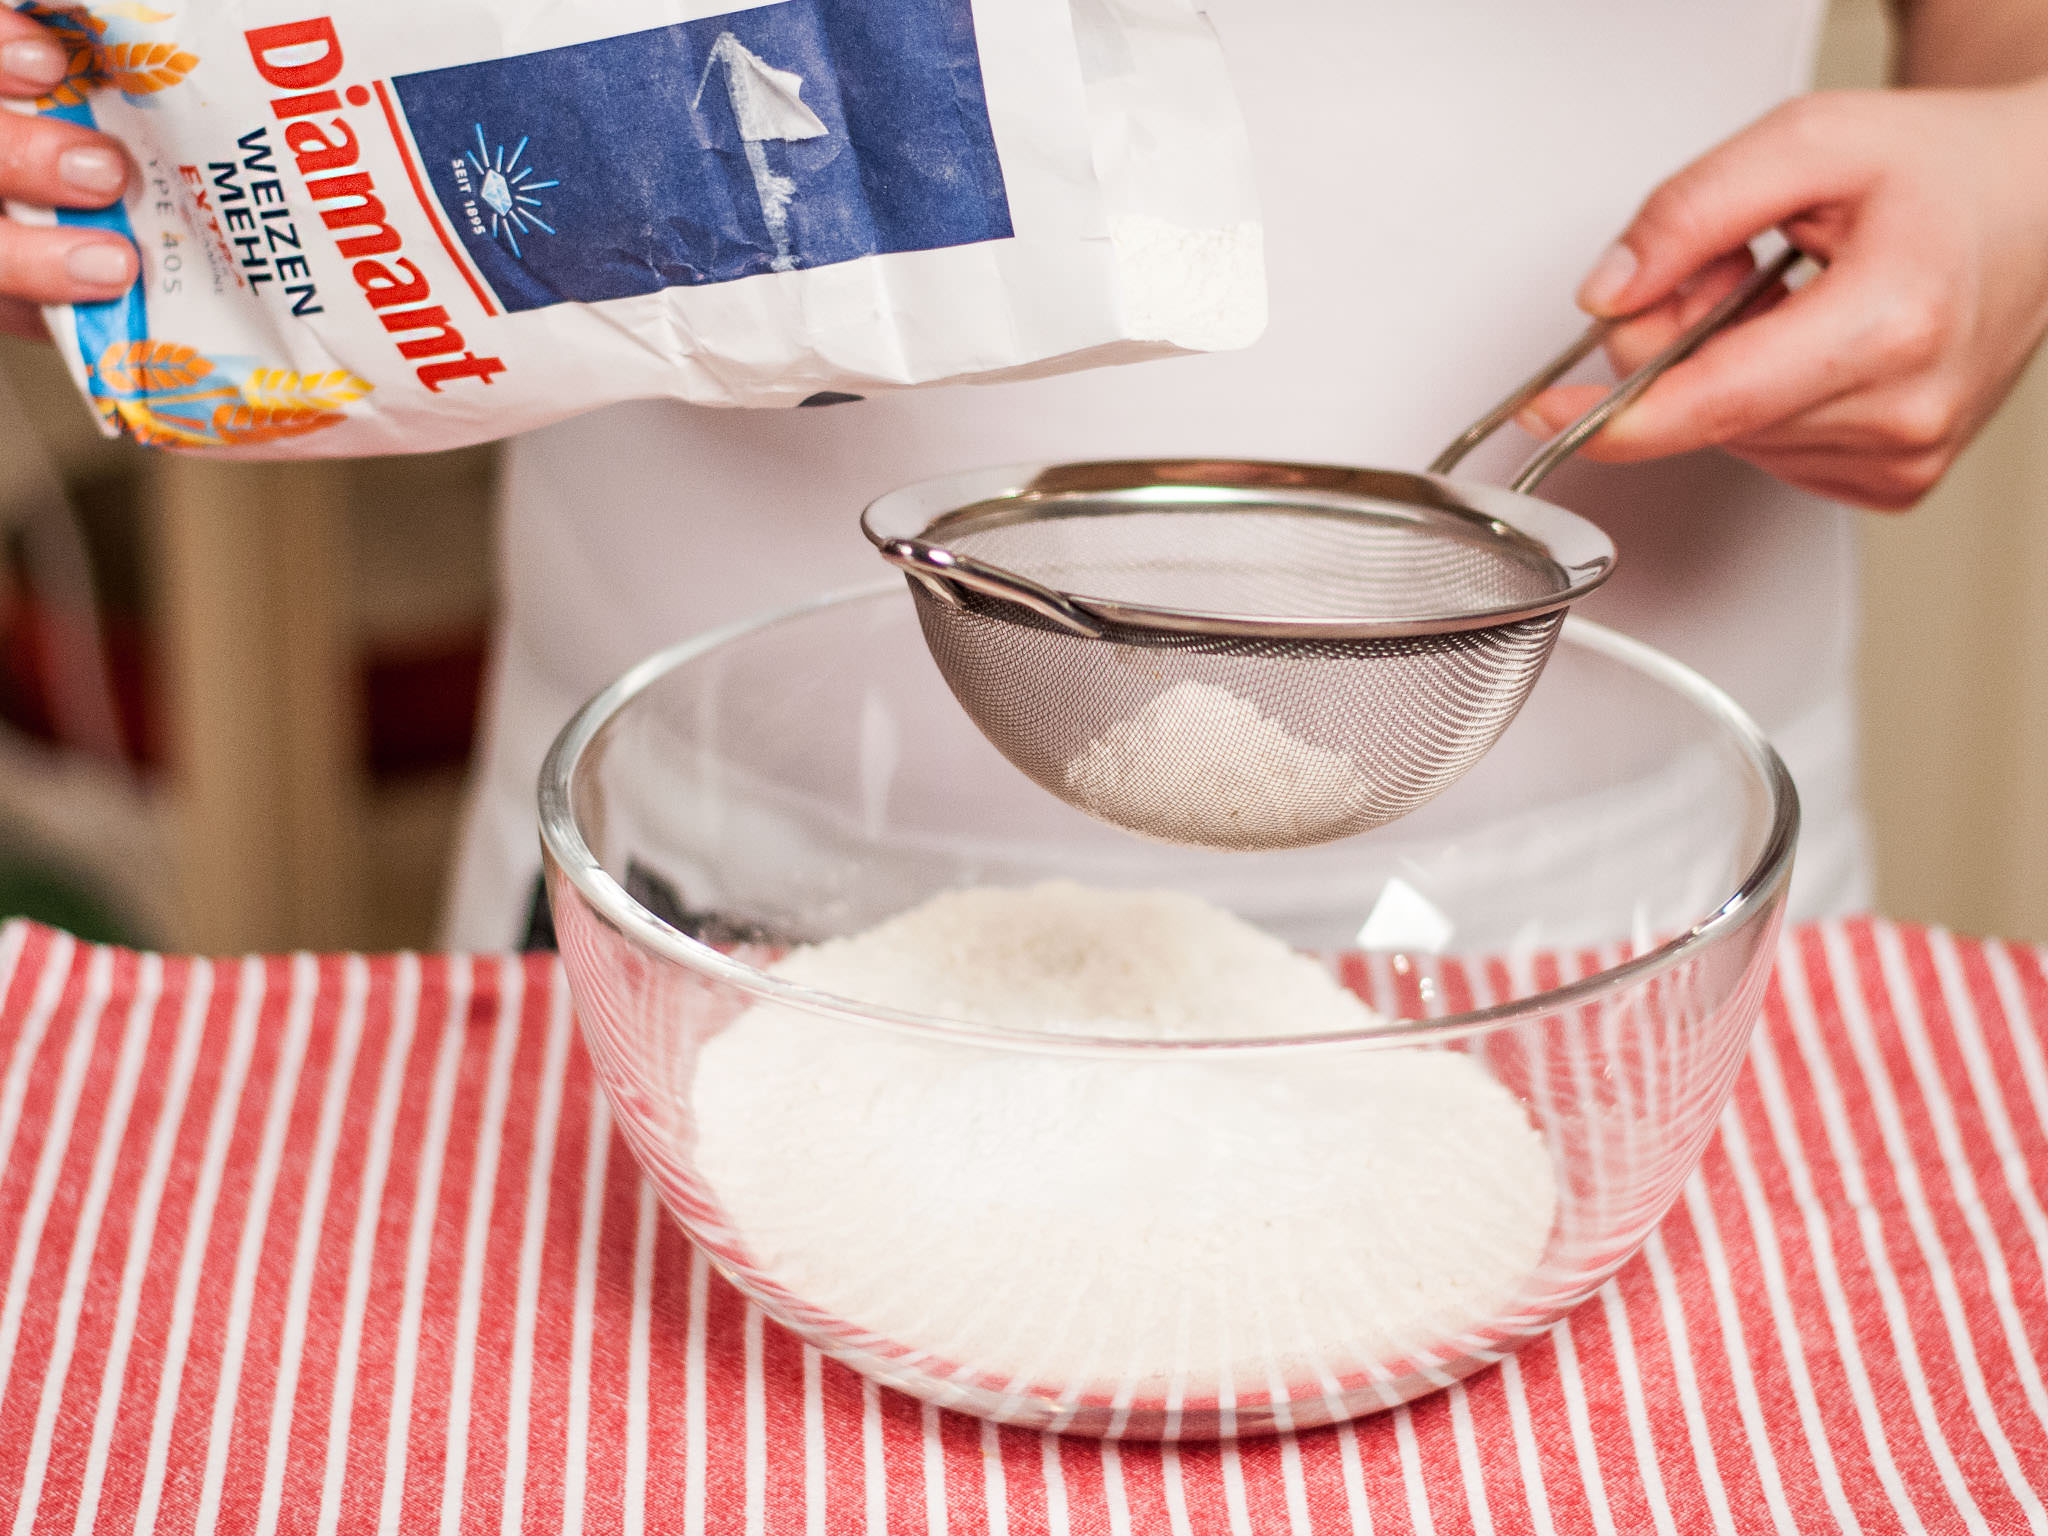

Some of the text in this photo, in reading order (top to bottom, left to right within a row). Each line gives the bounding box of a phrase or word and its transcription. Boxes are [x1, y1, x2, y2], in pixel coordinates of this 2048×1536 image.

[162, 231, 183, 294] 405
[208, 162, 260, 296] MEHL
[237, 127, 324, 317] WEIZEN
[244, 17, 507, 393] Diamant
[452, 159, 486, 235] SEIT 1895
